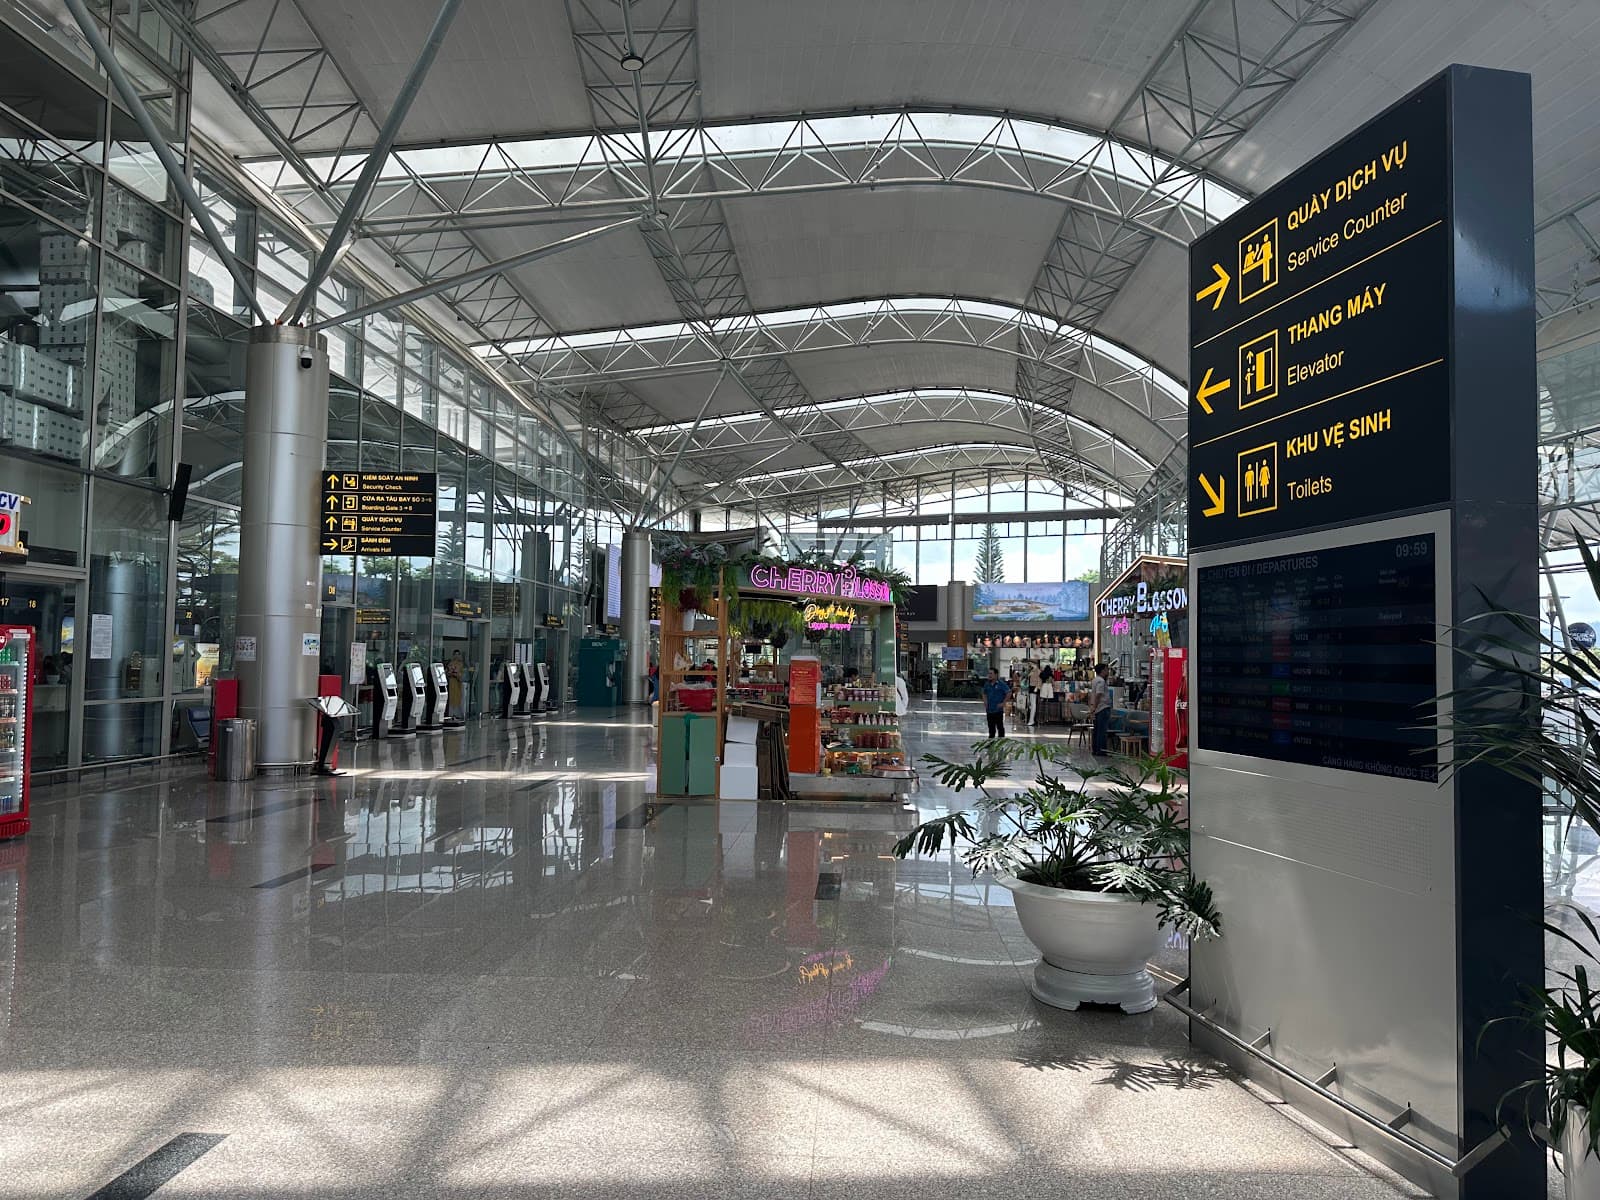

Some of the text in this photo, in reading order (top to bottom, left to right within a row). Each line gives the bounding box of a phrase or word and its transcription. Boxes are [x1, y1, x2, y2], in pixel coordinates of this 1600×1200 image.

[1335, 160, 1377, 203] DỊCH
[1381, 140, 1408, 172] VỤ
[1287, 192, 1408, 272] Service Counter
[1287, 282, 1386, 345] THANG MÁY
[1287, 350, 1344, 386] Elevator
[1286, 408, 1391, 458] KHU VỆ SINH
[1287, 475, 1333, 501] Toilets
[1257, 555, 1319, 576] DEPARTURES
[1395, 541, 1428, 558] 09:59
[751, 564, 841, 595] CHERRY
[1100, 595, 1135, 617] CHERRY
